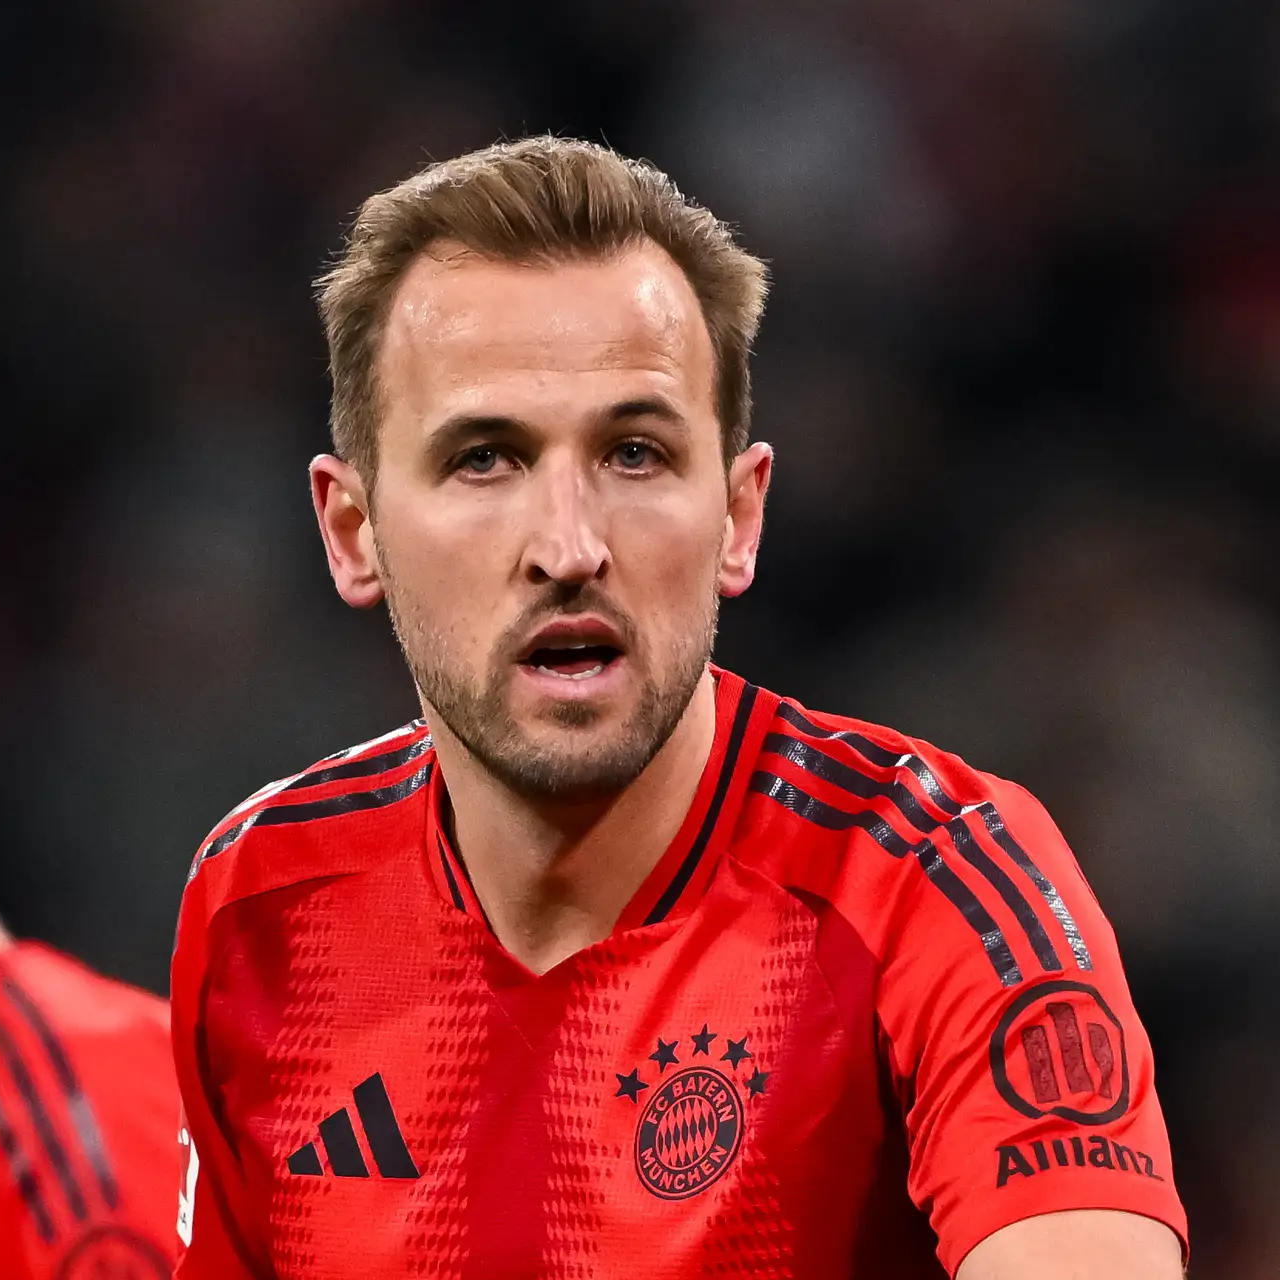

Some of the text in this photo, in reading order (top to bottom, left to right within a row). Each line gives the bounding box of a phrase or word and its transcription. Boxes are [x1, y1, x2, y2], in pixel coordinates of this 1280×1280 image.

[646, 1076, 735, 1125] FC BAYERN
[995, 1135, 1165, 1189] Allianz
